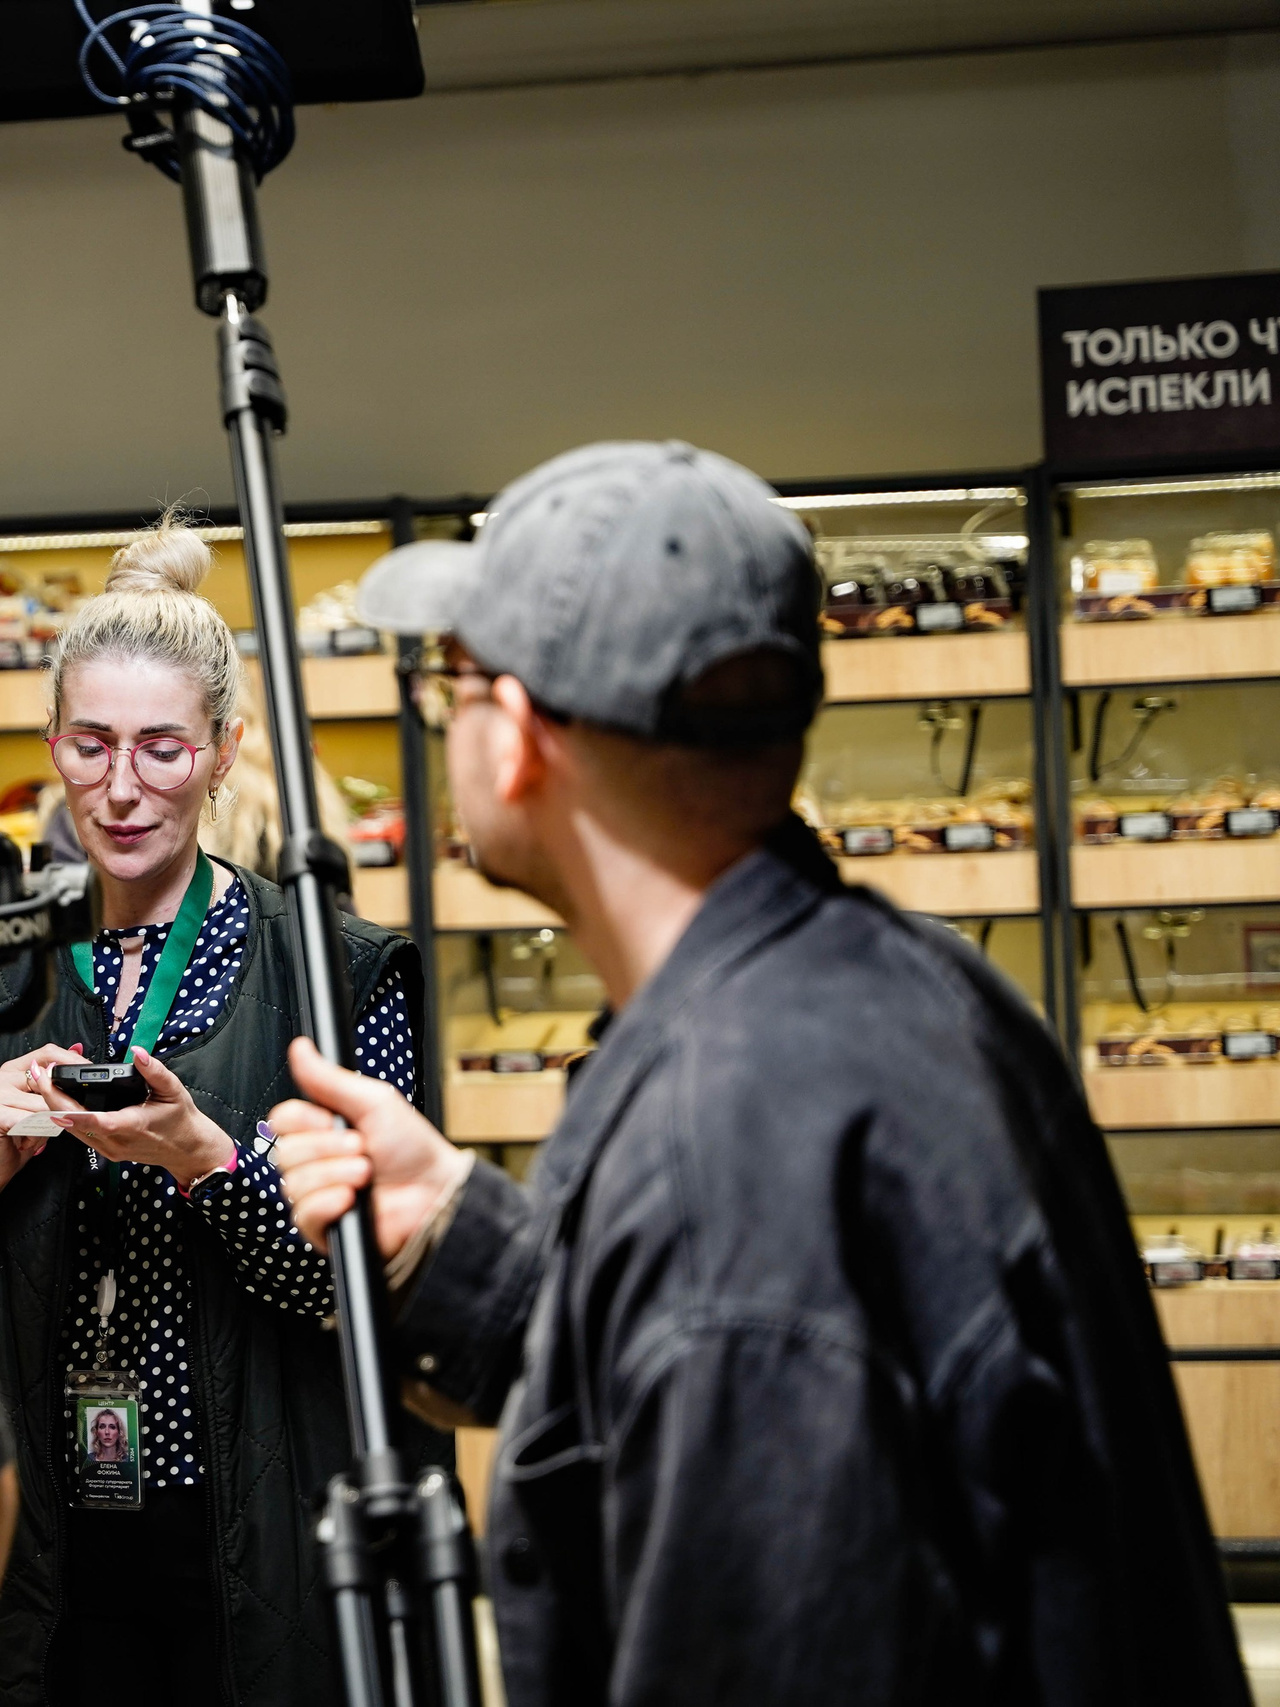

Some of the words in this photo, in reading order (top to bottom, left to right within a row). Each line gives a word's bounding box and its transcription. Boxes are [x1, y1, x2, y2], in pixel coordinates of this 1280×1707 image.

[1061, 319, 1240, 368] ТОЛЬКО
[1248, 316, 1280, 356] Ч
[1066, 366, 1272, 418] ИСПЕКЛИ
